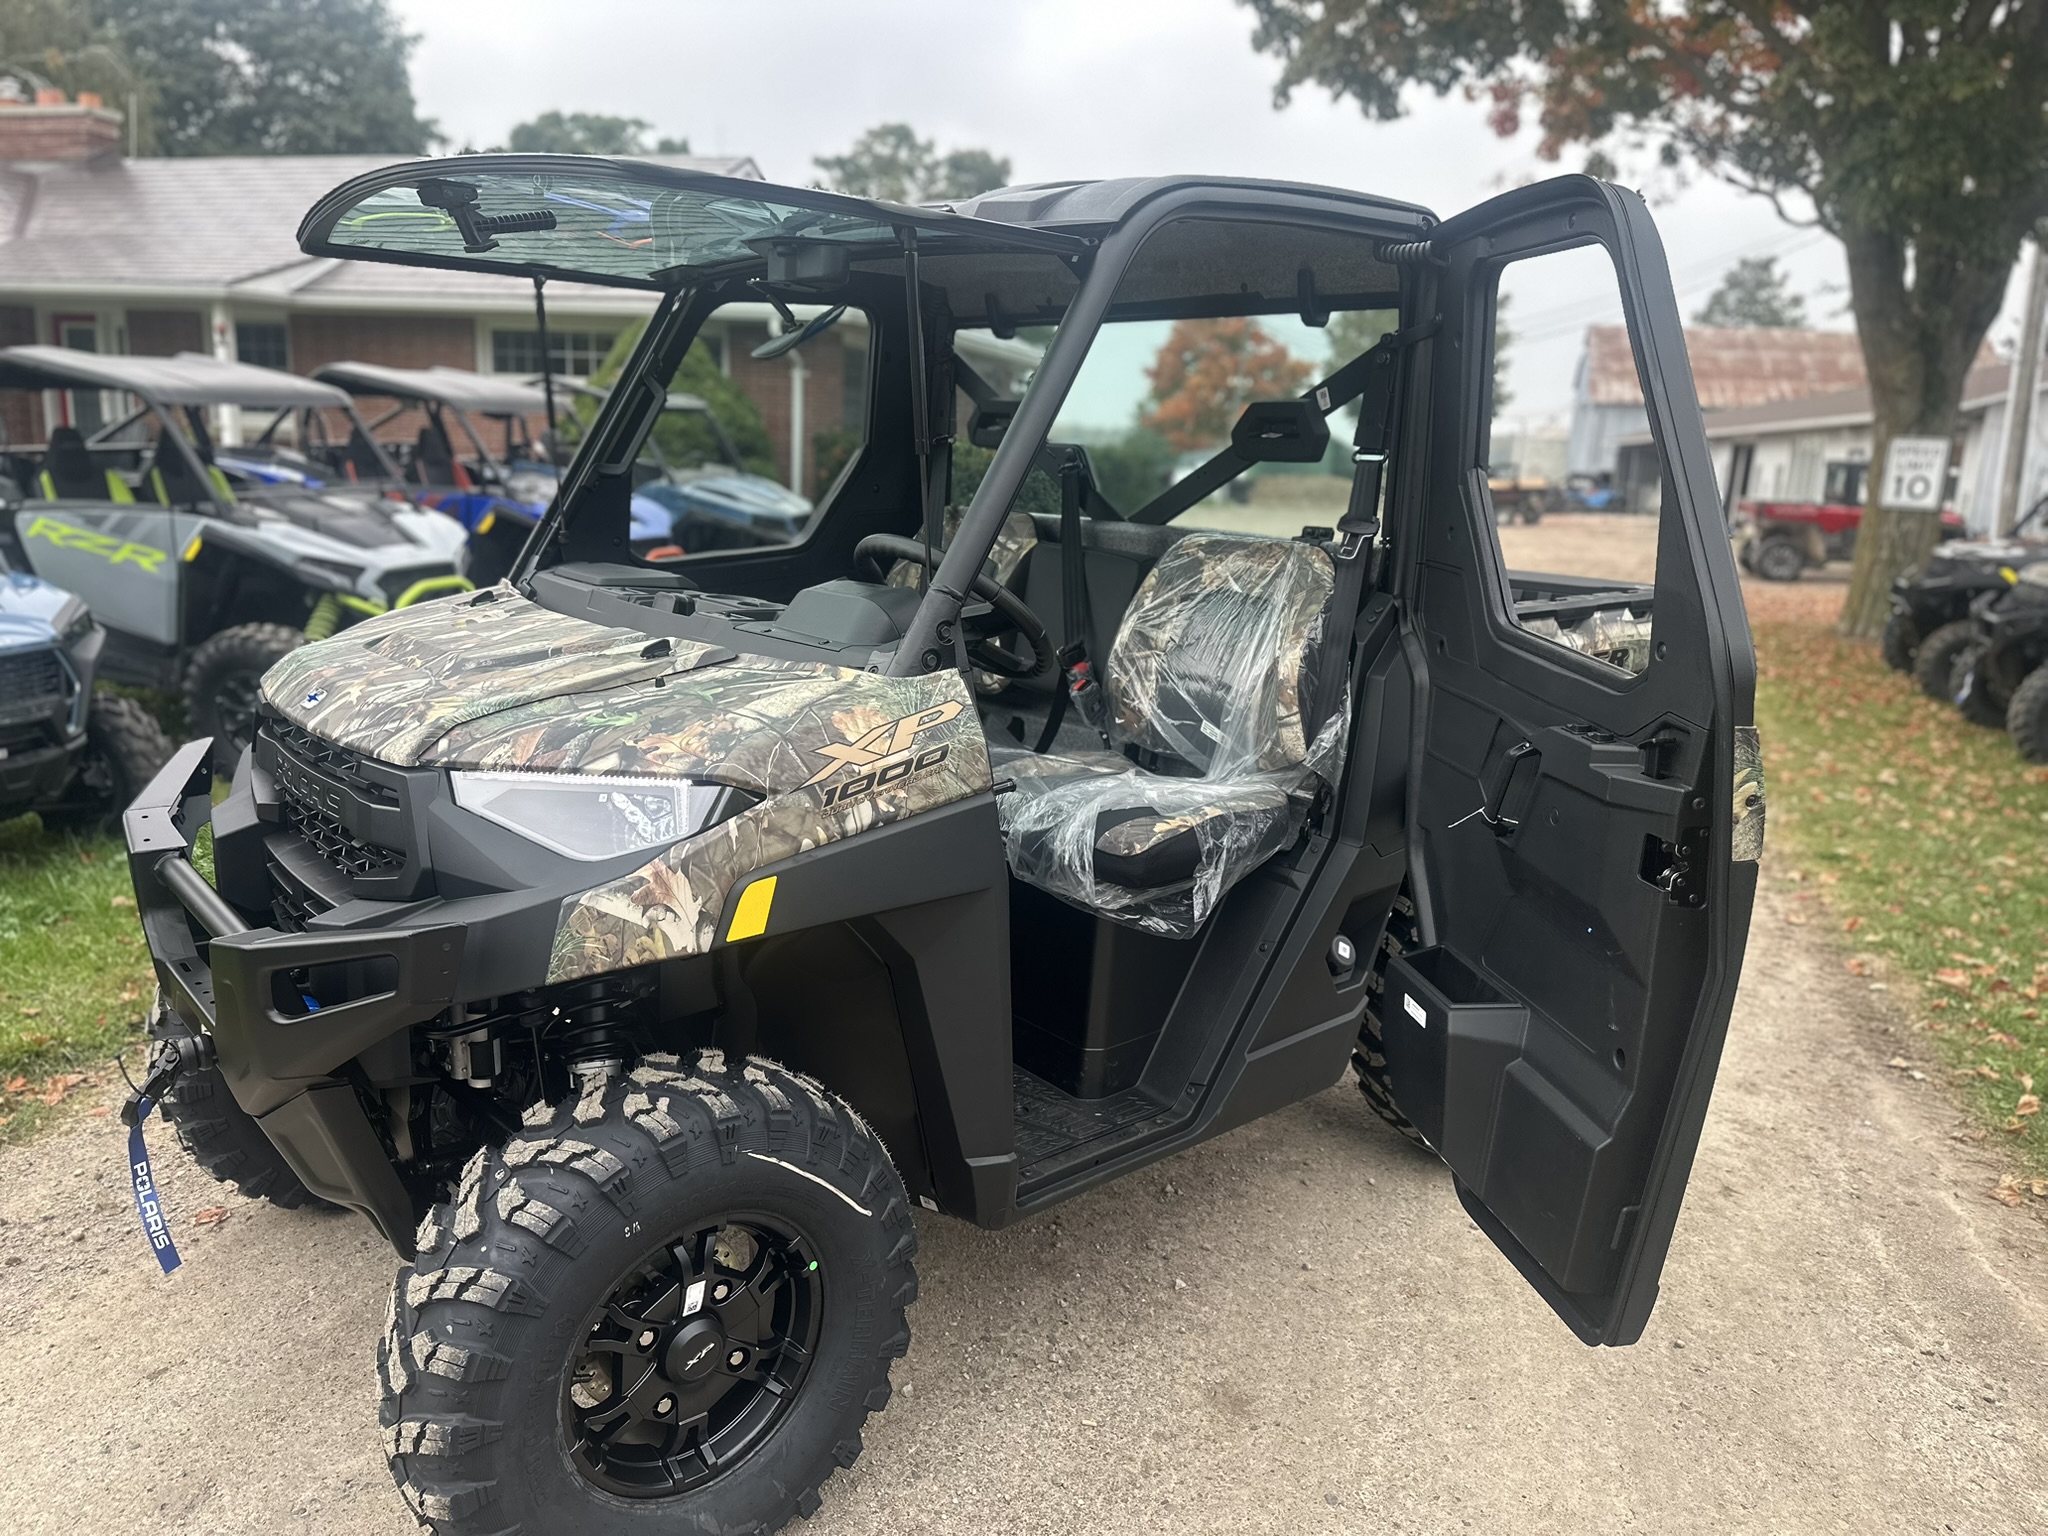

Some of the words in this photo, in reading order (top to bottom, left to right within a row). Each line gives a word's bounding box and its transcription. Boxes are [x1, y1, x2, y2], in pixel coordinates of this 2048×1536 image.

[1894, 474, 1932, 501] 10
[26, 517, 167, 574] RZR
[788, 699, 965, 794] XP
[822, 743, 952, 809] 1000
[276, 752, 341, 819] POLARIS
[133, 1161, 170, 1250] POLARIS
[685, 1343, 715, 1371] XP
[826, 1249, 877, 1413] X-TERRAIN
